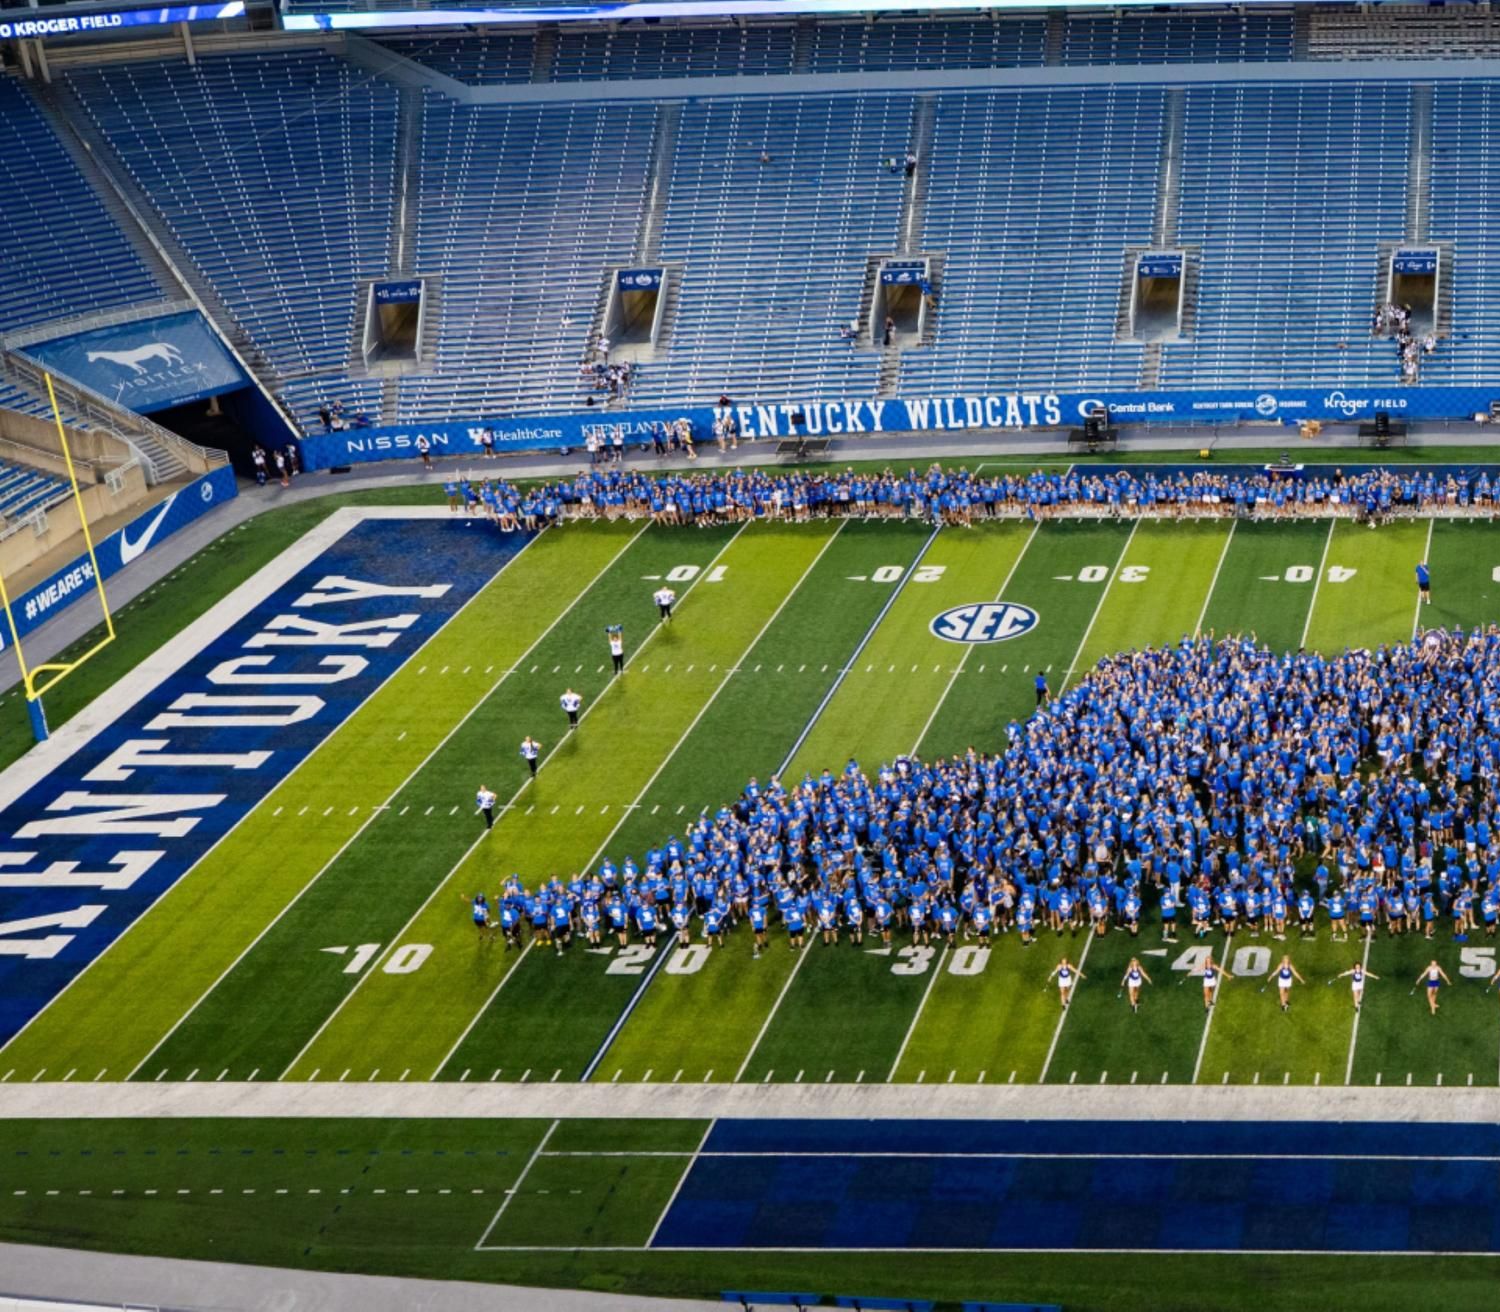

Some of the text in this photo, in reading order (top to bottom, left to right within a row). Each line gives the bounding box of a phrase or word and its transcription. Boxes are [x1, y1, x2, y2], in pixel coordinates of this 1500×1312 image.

[14, 17, 79, 36] KROGER
[80, 14, 122, 29] FIELD
[903, 395, 1061, 431] WILDCATS
[1108, 402, 1176, 413] Central Bank
[1323, 391, 1408, 416] Kroger FIELD
[347, 432, 449, 453] NISSAN
[493, 427, 563, 442] HealthCare
[666, 565, 726, 582] 10
[871, 565, 948, 582] 20
[1077, 565, 1151, 582] 30
[1284, 565, 1358, 583] 40
[940, 603, 1034, 642] SEC
[342, 943, 434, 974] 10
[604, 946, 711, 975] 20
[889, 945, 993, 976] 30
[1171, 945, 1272, 977] 40
